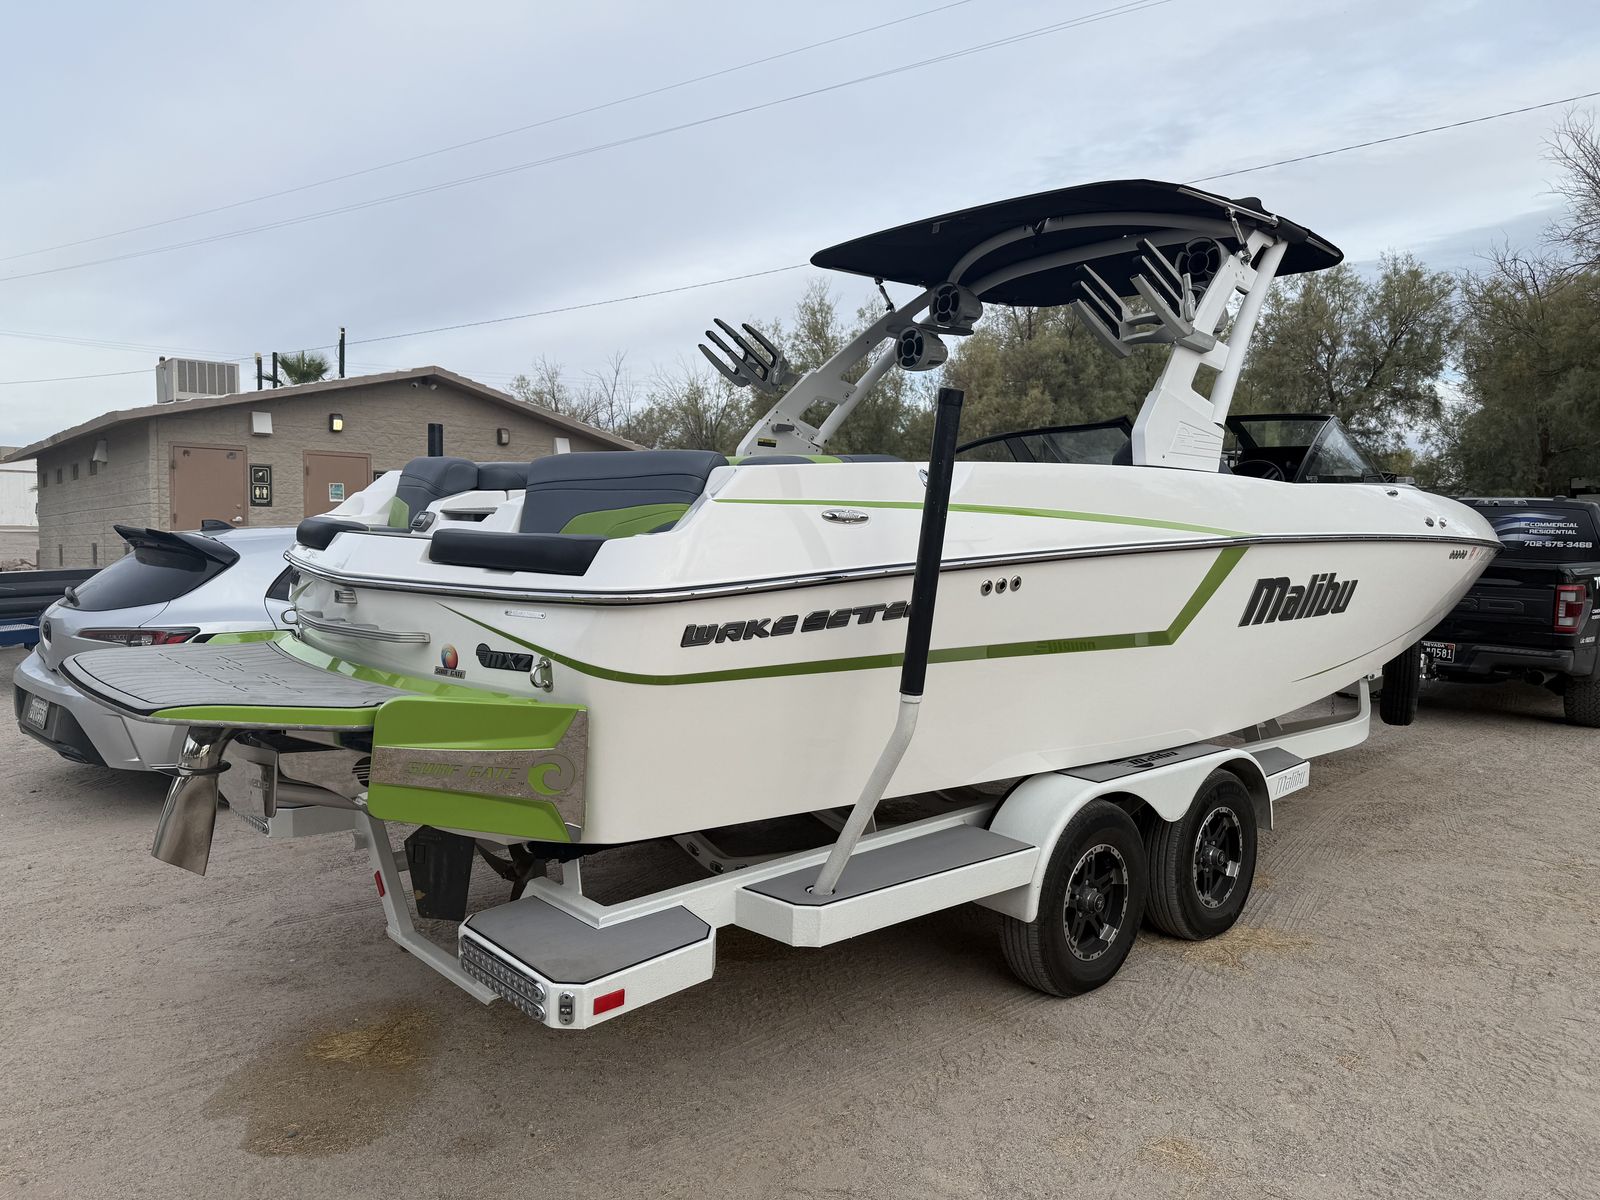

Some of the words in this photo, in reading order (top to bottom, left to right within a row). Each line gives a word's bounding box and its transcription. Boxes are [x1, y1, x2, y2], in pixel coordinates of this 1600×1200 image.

[1237, 572, 1359, 628] Malibu
[680, 614, 799, 648] WAKE
[407, 761, 463, 777] SURF
[466, 765, 521, 780] GATE
